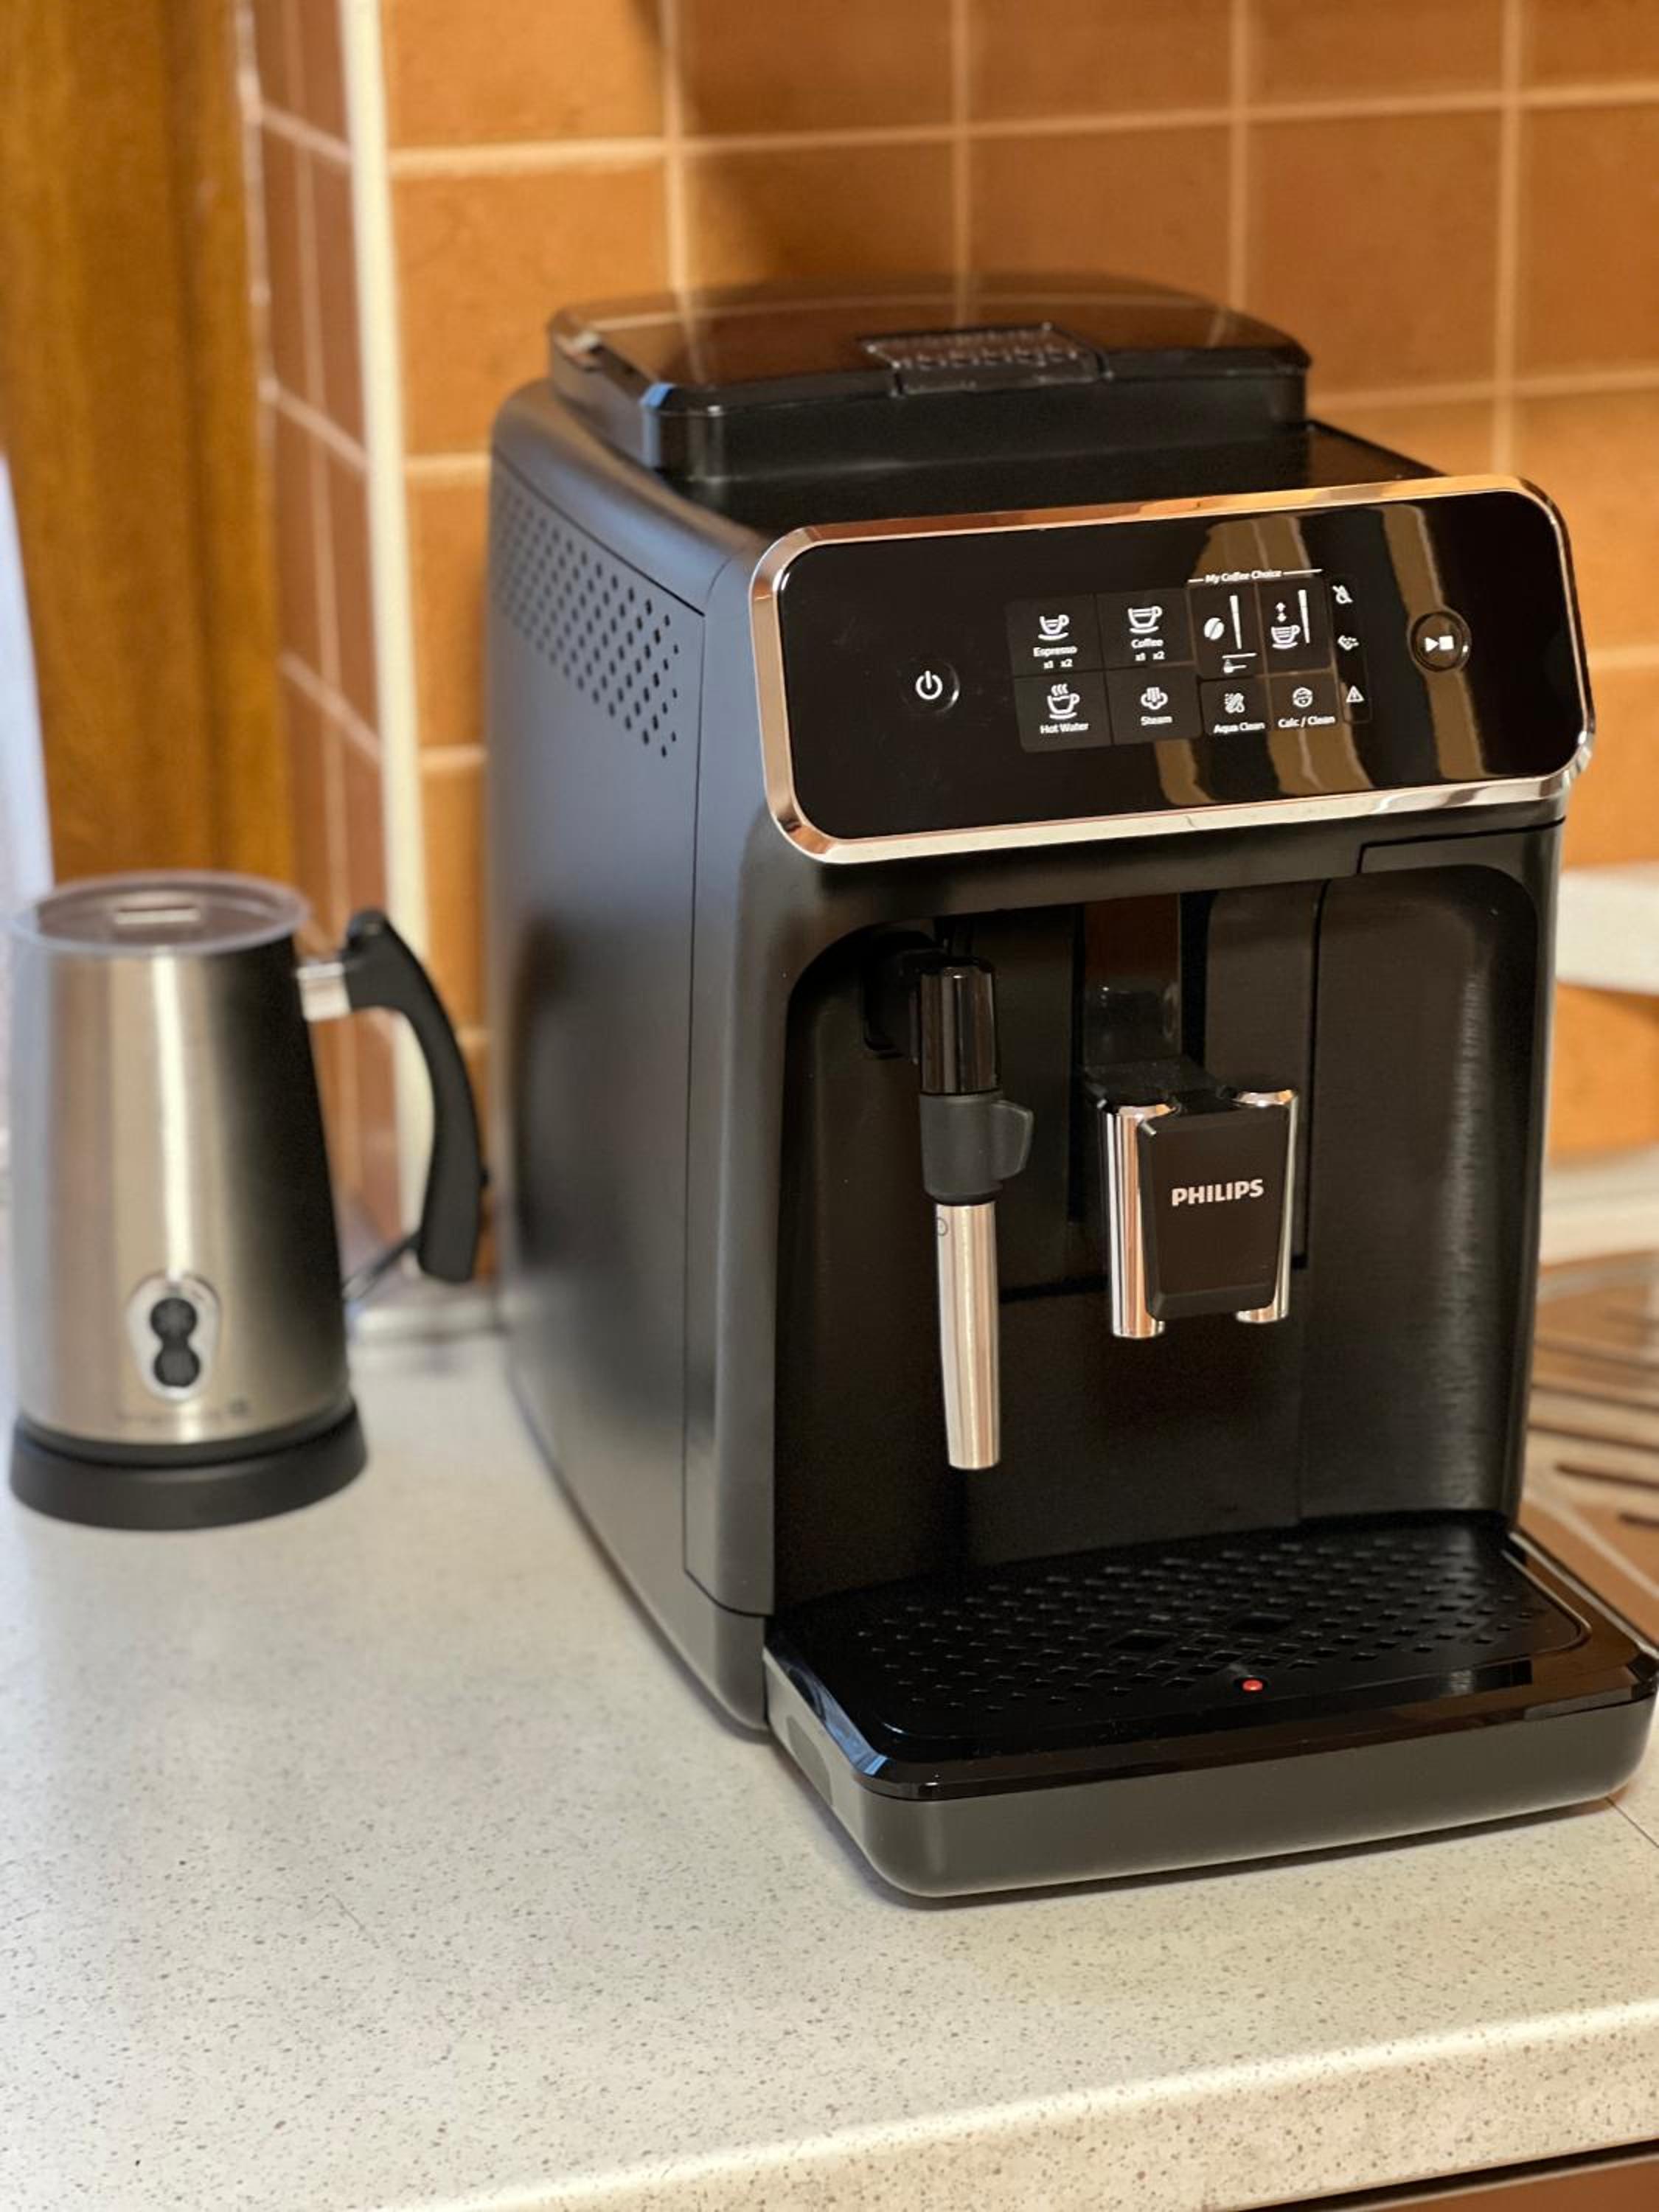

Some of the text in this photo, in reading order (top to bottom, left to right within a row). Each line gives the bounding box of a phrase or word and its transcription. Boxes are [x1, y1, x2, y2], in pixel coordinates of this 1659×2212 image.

[1205, 569, 1282, 583] My Coffee Choice
[1131, 638, 1164, 649] Coffee
[1033, 646, 1078, 657] Espresso
[1141, 716, 1172, 726] Steam
[1278, 718, 1300, 728] Calc
[1307, 716, 1335, 726] Clean
[1040, 723, 1089, 734] Hot Water
[1214, 722, 1265, 734] Aqua Clean
[1172, 1179, 1264, 1206] PHILIPS
